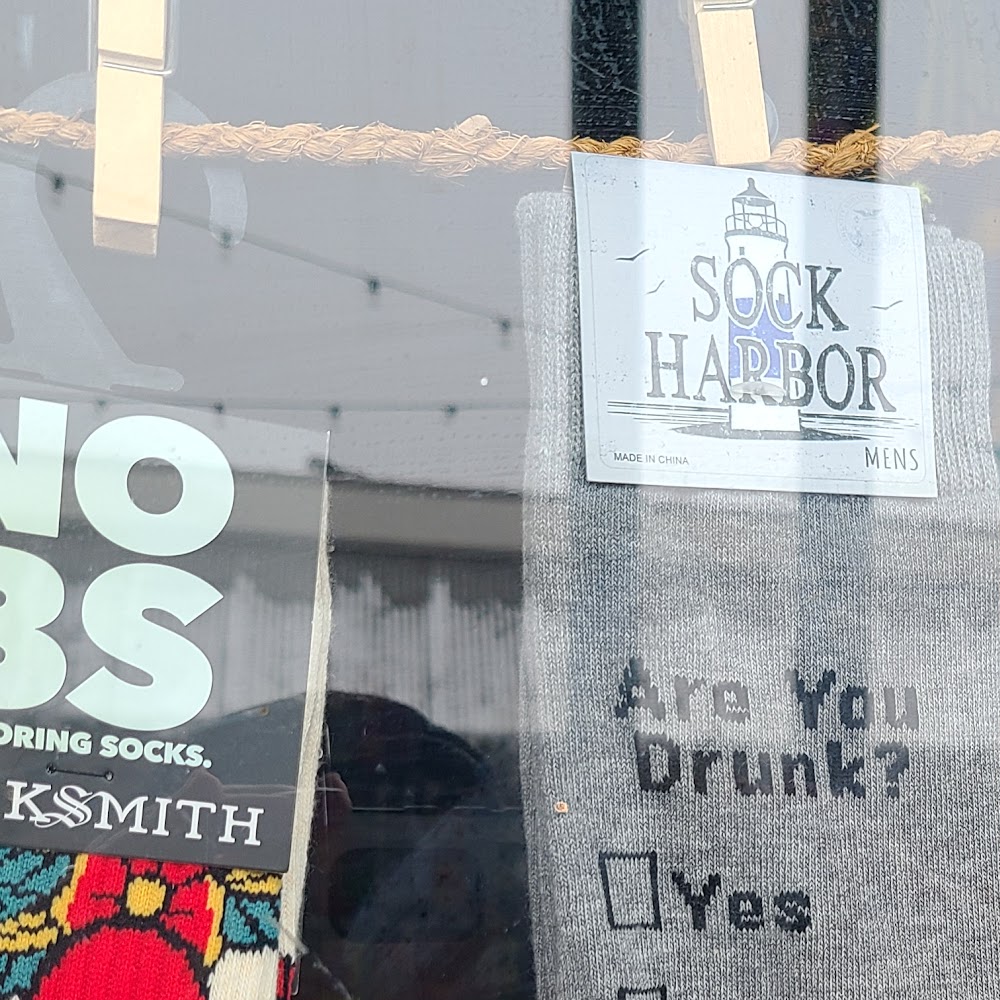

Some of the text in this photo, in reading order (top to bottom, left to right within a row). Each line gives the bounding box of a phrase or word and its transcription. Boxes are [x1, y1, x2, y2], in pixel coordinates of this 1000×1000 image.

[690, 255, 849, 331] SOCK
[645, 331, 897, 412] HARBOR
[613, 452, 689, 465] MADE IN CHINA
[864, 446, 918, 471] MENS
[616, 659, 919, 731] Are You
[99, 735, 212, 768] SOCKS.
[635, 732, 911, 799] Drunk?
[4, 780, 265, 846] KSMITH
[672, 870, 812, 933] Yes
